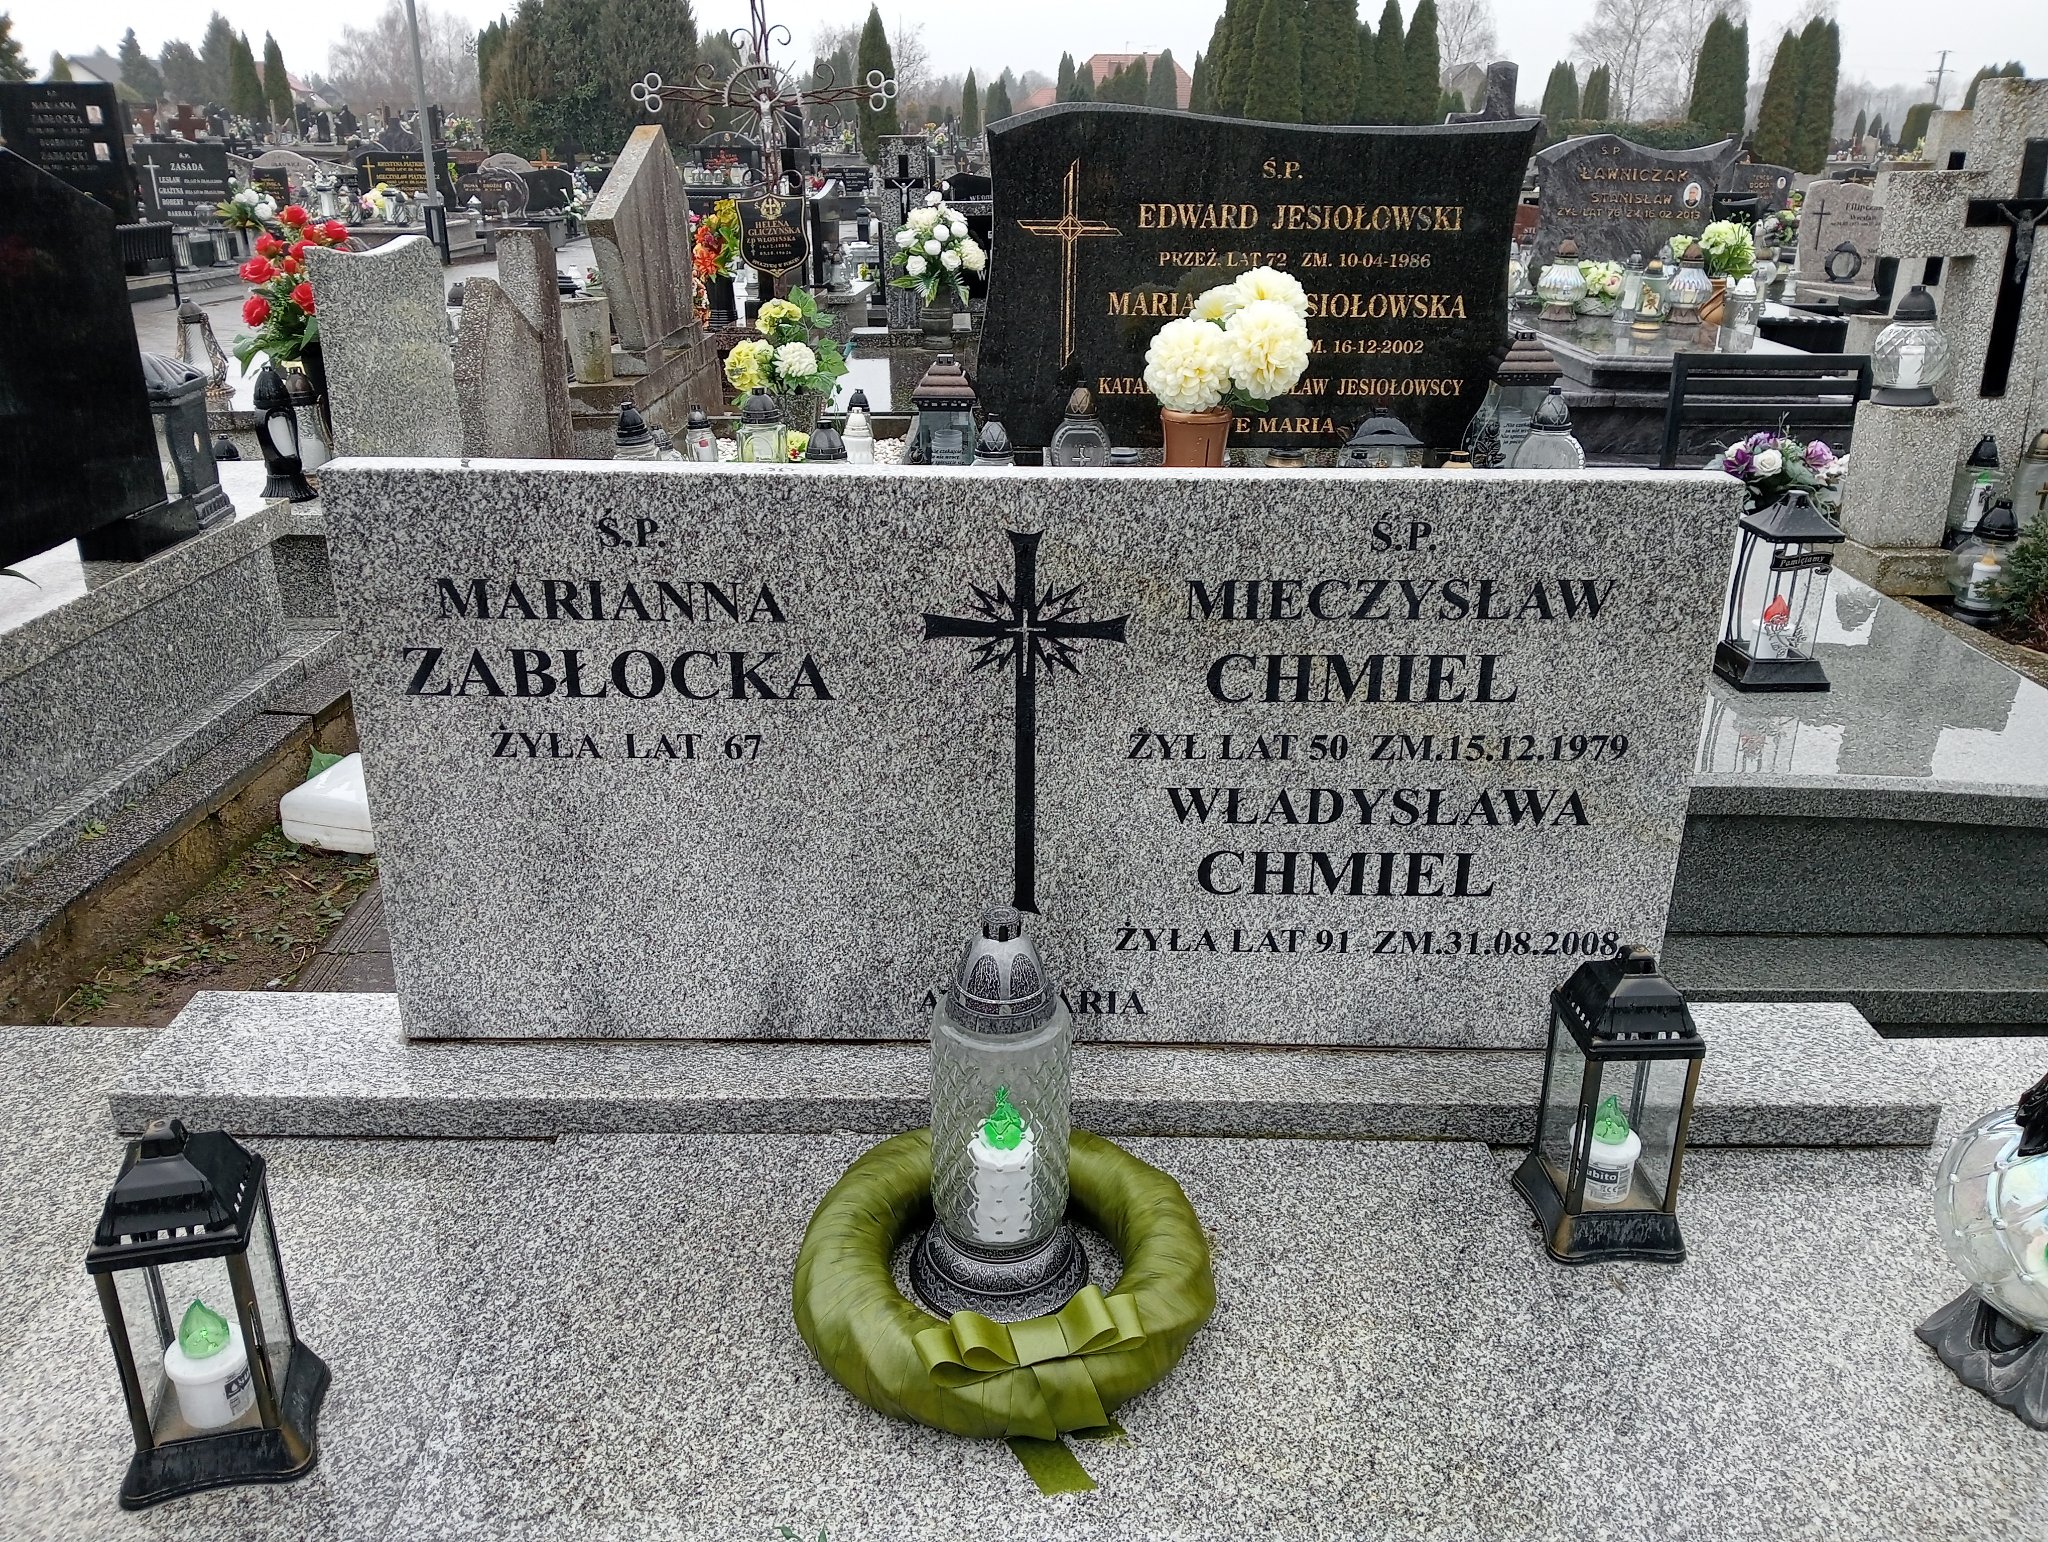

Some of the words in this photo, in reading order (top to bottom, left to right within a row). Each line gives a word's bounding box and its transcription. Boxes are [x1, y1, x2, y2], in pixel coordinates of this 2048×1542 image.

[170, 162, 204, 171] ZASADA
[1580, 166, 1689, 183] ŁAWNICZAK
[1591, 191, 1673, 205] STANISŁAW
[748, 226, 801, 236] GLICZYŃSKA
[755, 220, 789, 229] HELENA
[1137, 202, 1259, 230] EDWARD
[1272, 203, 1464, 232] JESIOŁOWSKI
[1158, 248, 1222, 268] PRZEŻ.
[1228, 251, 1262, 267] LAT
[1267, 252, 1288, 267] 72
[1301, 252, 1333, 268] ZM.
[1338, 252, 1432, 269] 10-04-1986
[1304, 292, 1467, 319] SIOŁOWSKA
[1333, 339, 1425, 355] 16-12-2002
[1336, 377, 1464, 397] JESIOŁOWSCY
[1258, 417, 1335, 434] MARIA
[599, 508, 667, 549] Ś.P.
[1370, 512, 1438, 553] Ś.P.
[1780, 556, 1825, 567] Pamiętamy
[436, 577, 789, 624] MARIANNA
[1185, 578, 1616, 622] MIECZYSŁAW
[402, 646, 837, 702] ZABŁOCKA
[1205, 653, 1520, 704] CHMIEL
[490, 724, 602, 760] ŻYŁA
[625, 732, 703, 761] LAT
[724, 733, 763, 762] 67
[1127, 727, 1208, 761] ŻYŁ
[1218, 734, 1299, 761] LAT
[1308, 733, 1349, 762] 50
[1371, 733, 1630, 763] ZM.15.12.1979
[1165, 786, 1592, 828] WŁADYSŁAWA
[1197, 849, 1496, 898] CHMIEL
[1115, 921, 1218, 952] ŻYŁA
[1231, 928, 1306, 954] LAT
[1316, 928, 1350, 955] 91
[1373, 929, 1620, 957] ZM.31.08.2008
[1587, 1169, 1617, 1181] ubito
